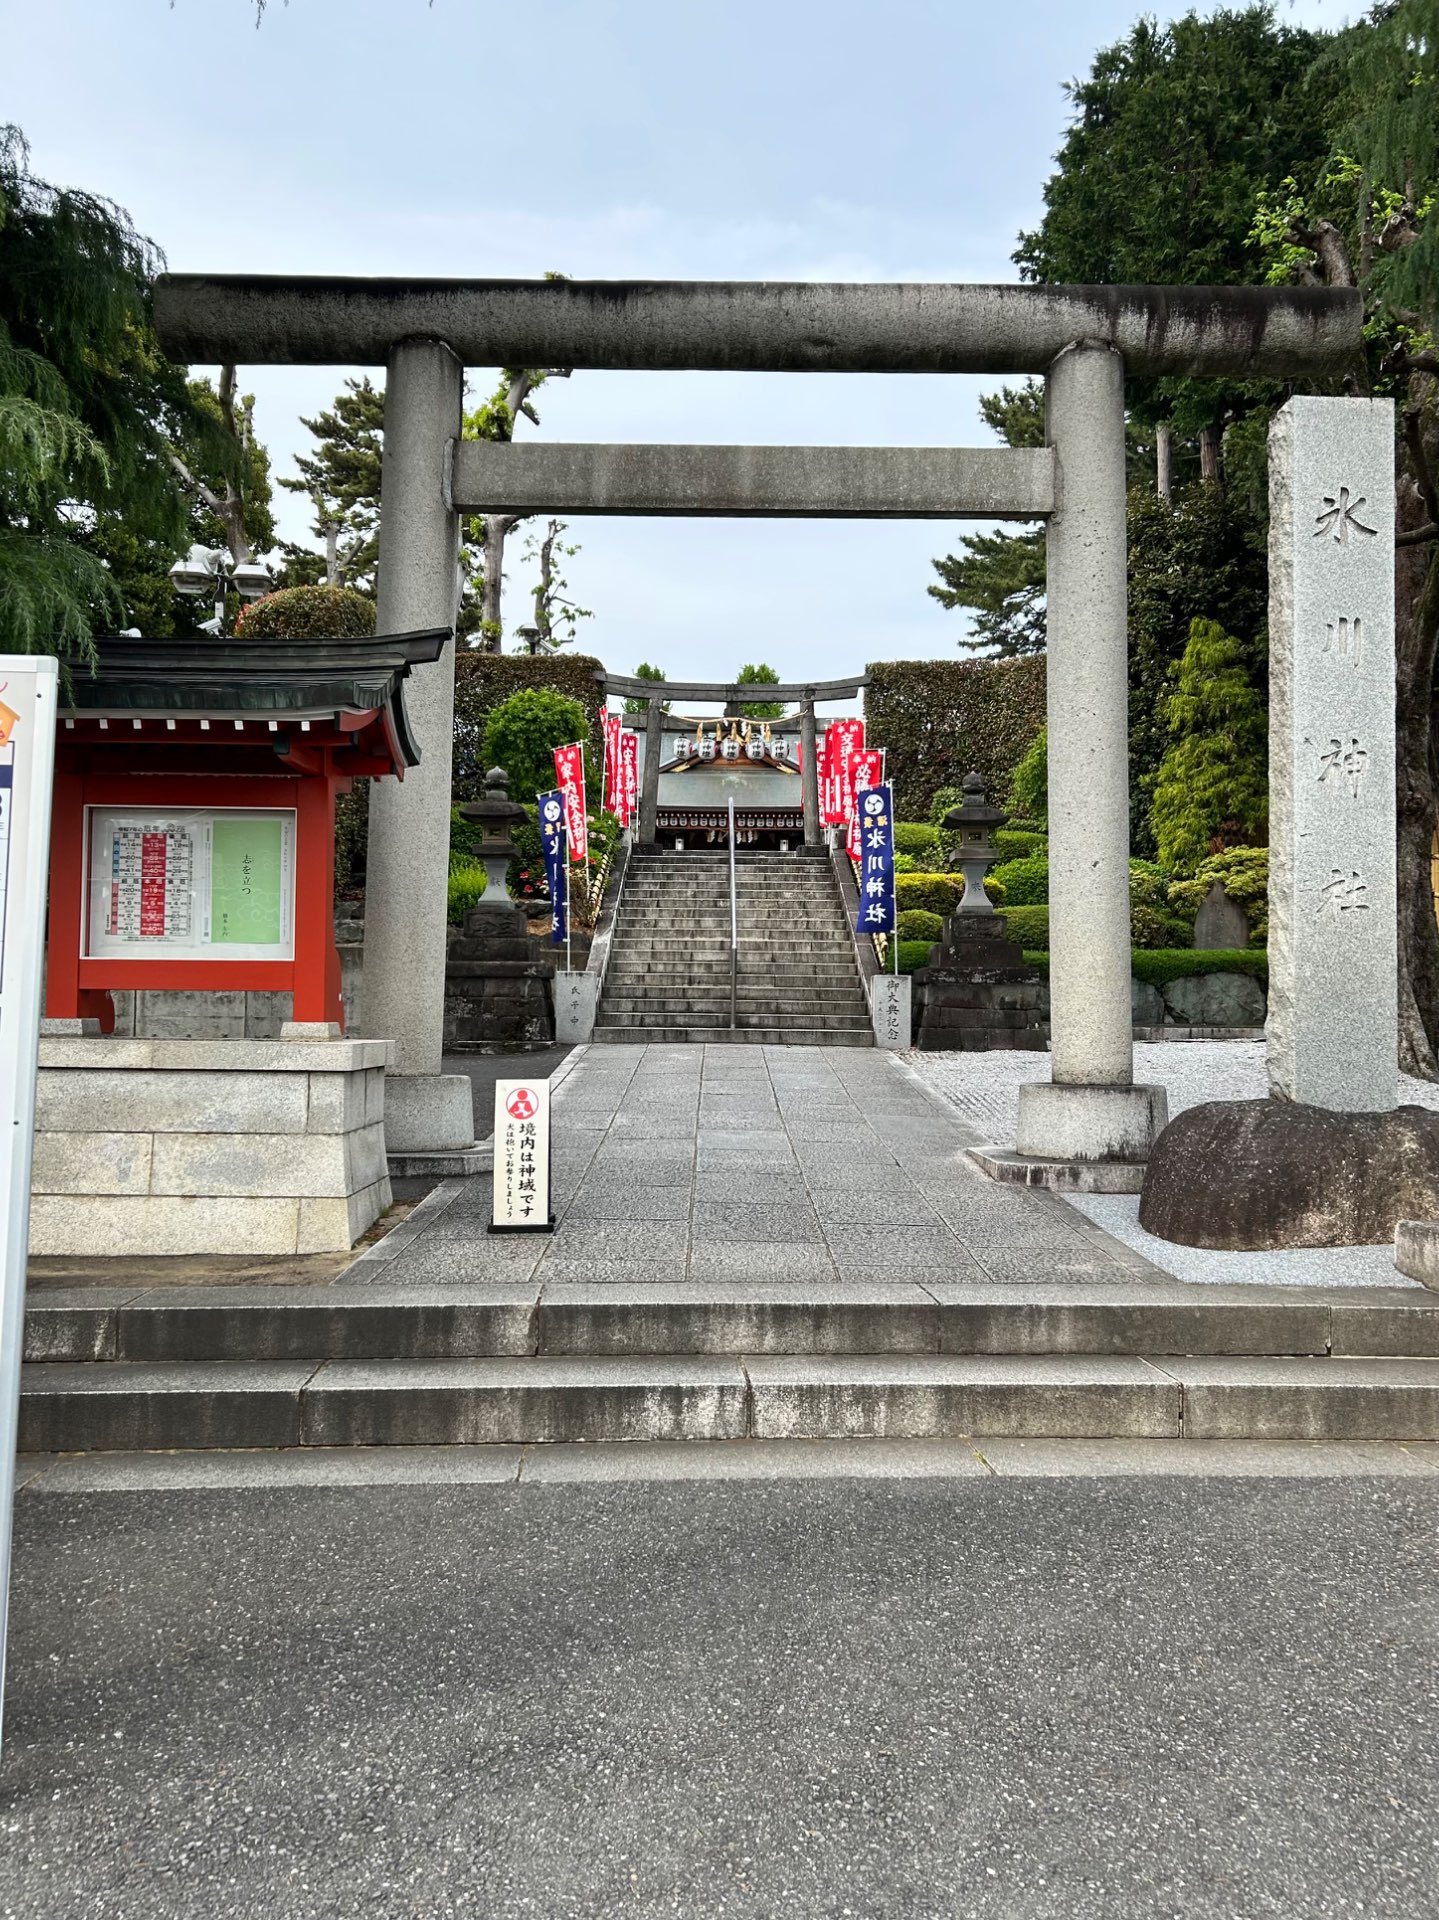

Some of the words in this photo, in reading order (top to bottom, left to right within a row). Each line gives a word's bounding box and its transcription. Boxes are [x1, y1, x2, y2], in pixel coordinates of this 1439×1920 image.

[1312, 486, 1378, 922] 氷川神社
[242, 853, 252, 895] 志を立つ
[570, 985, 581, 1026] 氏子中
[886, 979, 900, 1041] 御大典記念
[506, 1122, 516, 1218] 犬は抱いてお参りしましょう
[518, 1122, 537, 1218] 境内は神域です
